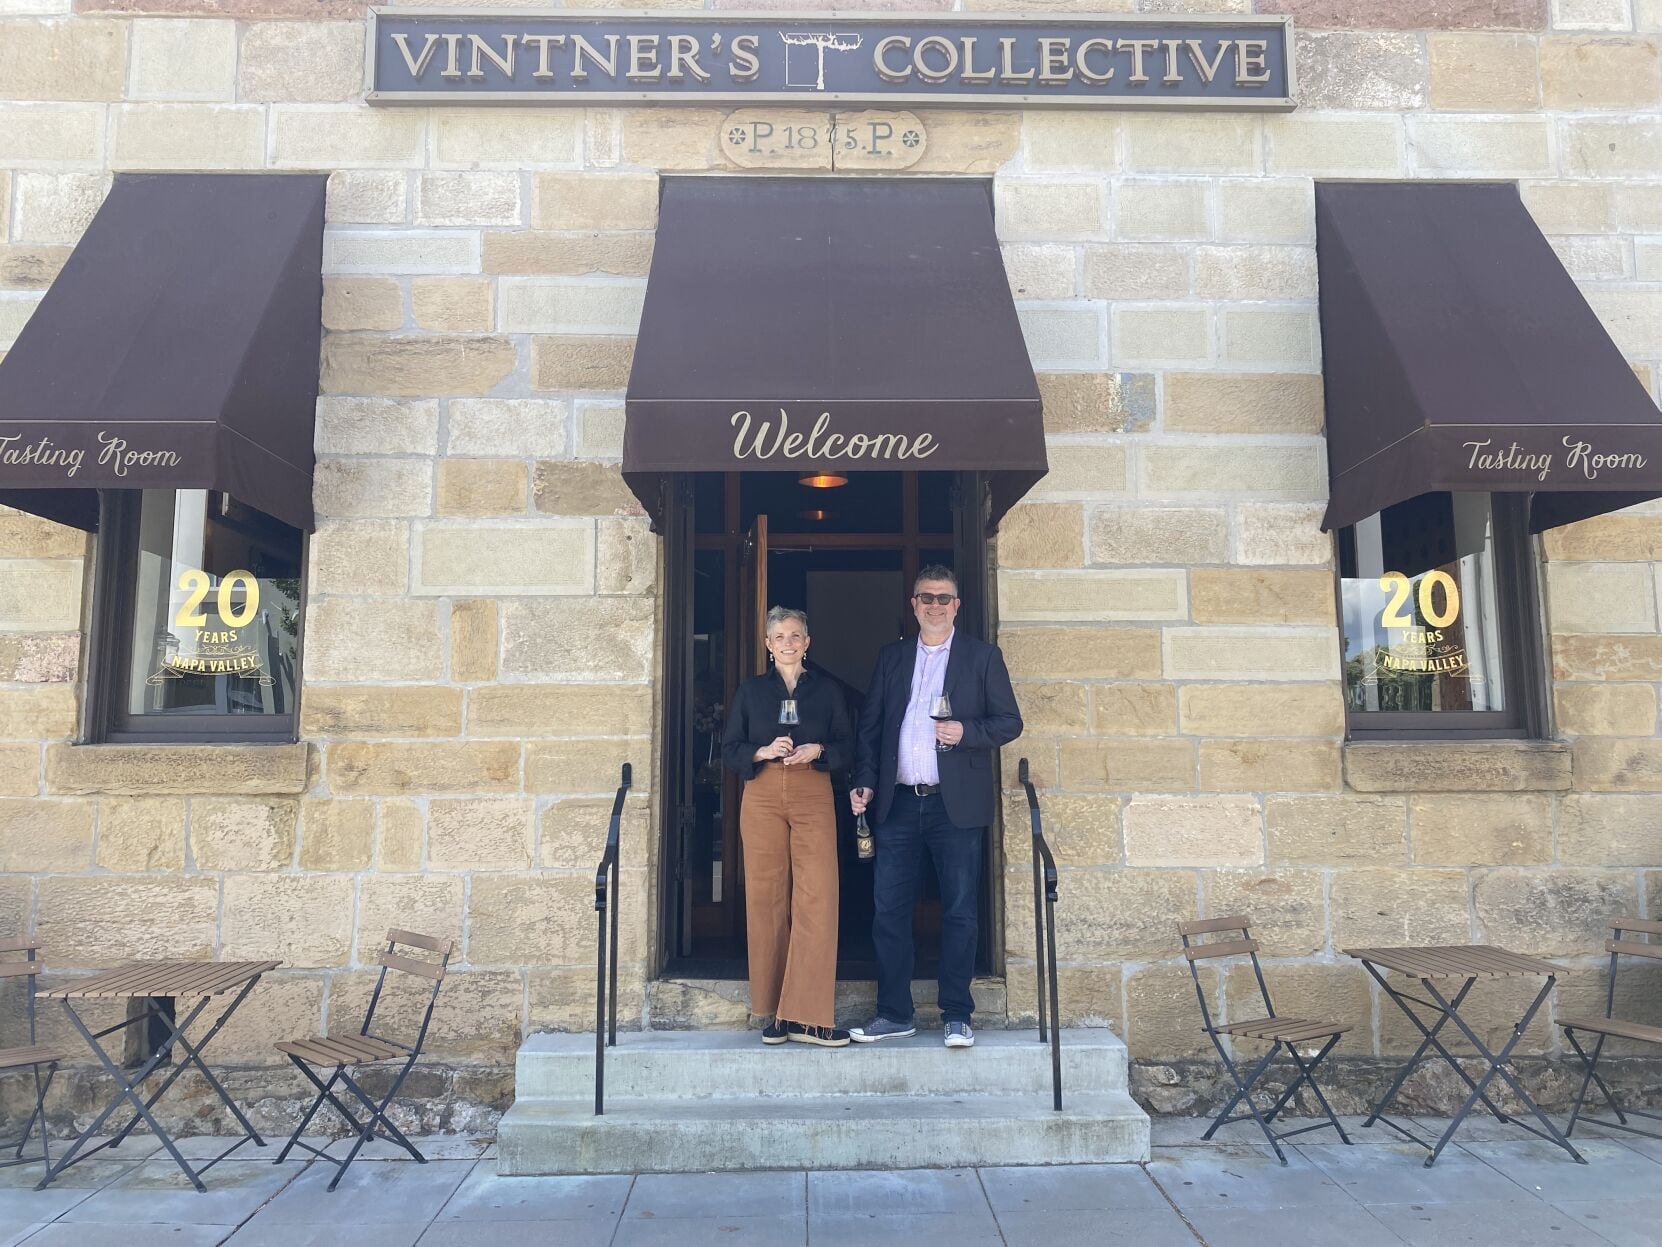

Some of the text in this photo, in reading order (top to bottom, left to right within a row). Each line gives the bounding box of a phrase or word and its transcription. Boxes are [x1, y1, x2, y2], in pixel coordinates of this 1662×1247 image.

[390, 32, 1273, 86] VINTNER'S COLLECTIVE
[0, 430, 182, 477] Tasting Room
[731, 408, 940, 460] Welcome
[1462, 435, 1648, 481] Tasting Room
[175, 569, 260, 628] 20
[1379, 570, 1460, 628] 20
[194, 630, 238, 643] YEARS
[1402, 630, 1444, 643] YEARS
[171, 655, 256, 672] NAPA VALLEY
[1383, 654, 1465, 671] NAPA VALLEY
